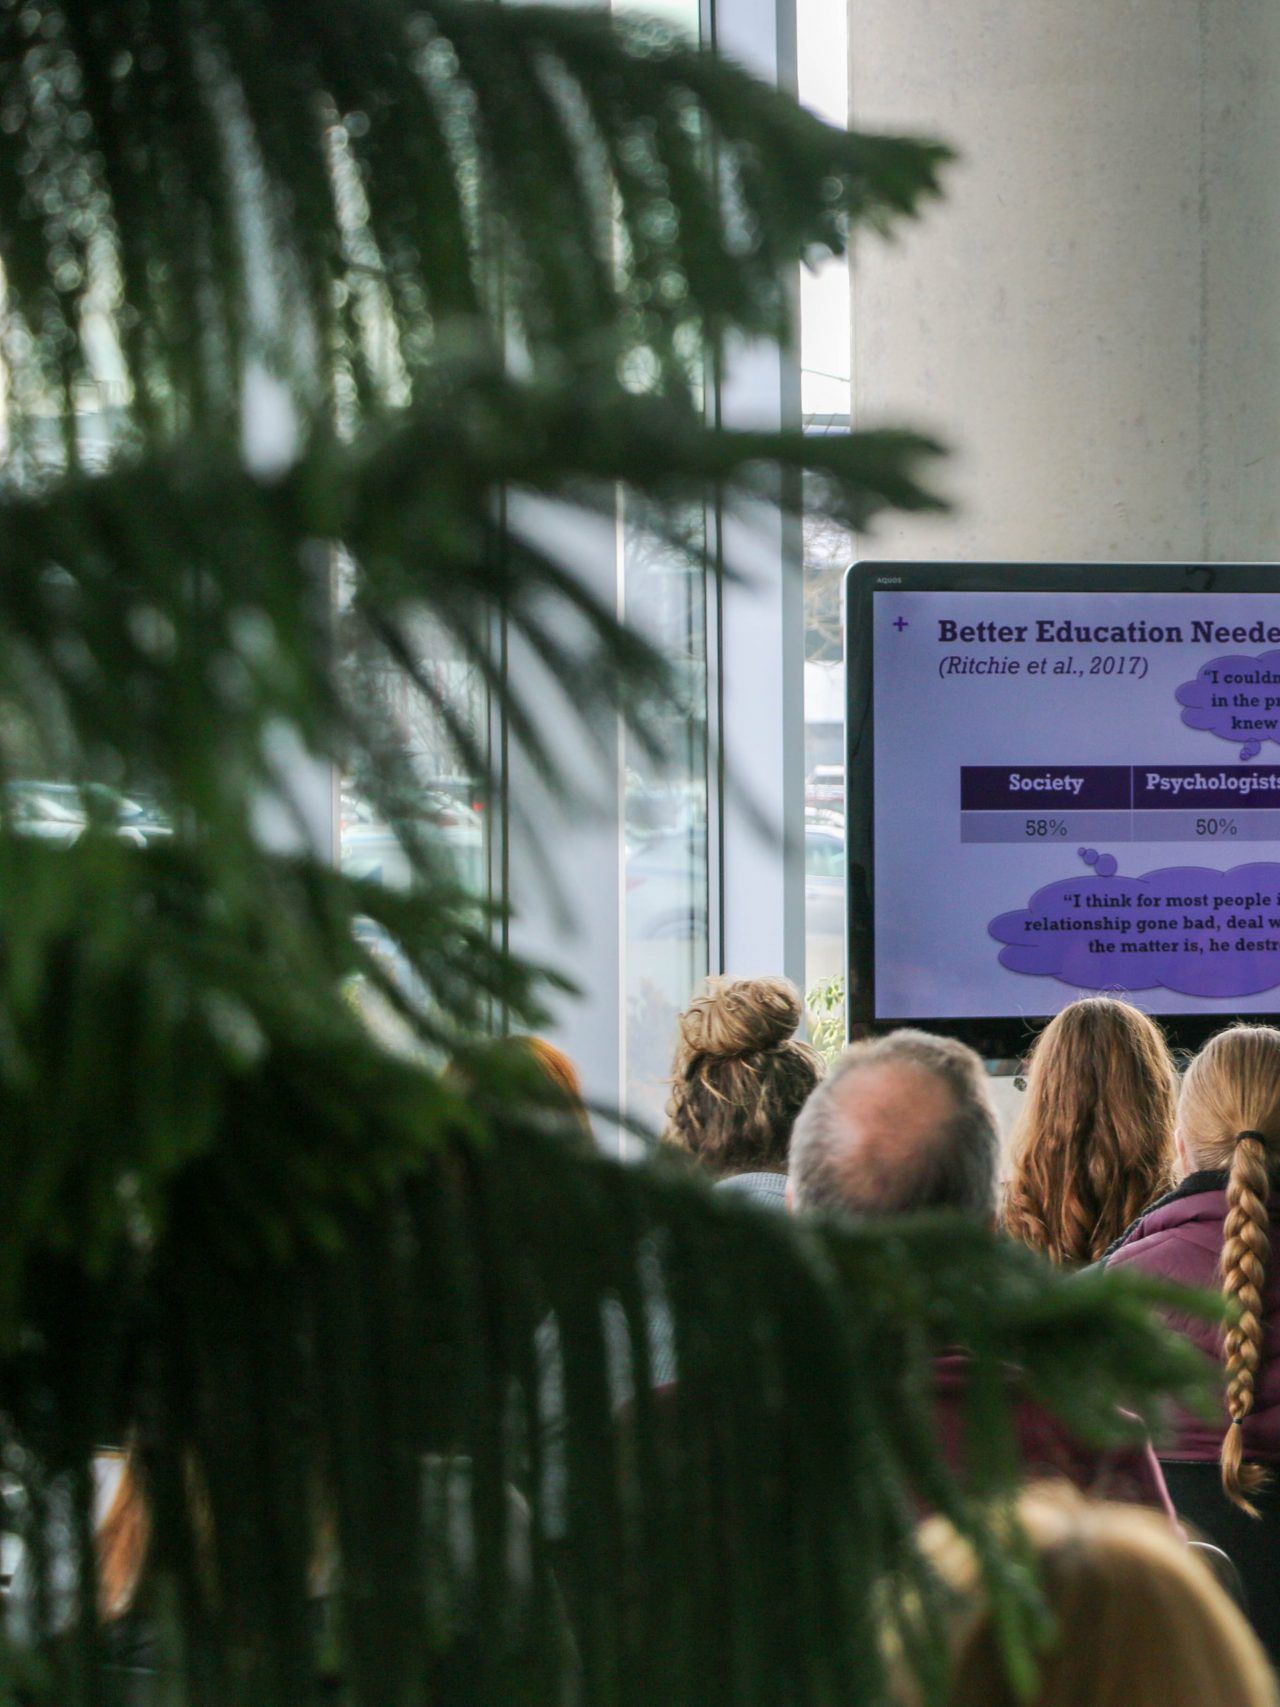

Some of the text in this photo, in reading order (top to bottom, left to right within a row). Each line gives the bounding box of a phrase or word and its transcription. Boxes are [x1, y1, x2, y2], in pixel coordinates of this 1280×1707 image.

[938, 620, 1028, 643] Better
[1035, 620, 1183, 643] Education
[938, 655, 1149, 678] (Ritchie et al., 2017)
[1211, 694, 1228, 707] in
[1233, 694, 1260, 707] the
[1231, 716, 1278, 729] knew
[1008, 773, 1085, 795] Society
[1025, 819, 1068, 837] 58%
[1195, 818, 1238, 835] 50%
[1086, 893, 1133, 907] think
[1137, 893, 1161, 907] for
[1166, 893, 1209, 907] most
[1213, 892, 1271, 910] people
[1024, 917, 1132, 934] relationship
[1136, 919, 1178, 933] gone
[1183, 916, 1222, 932] bad,
[1226, 915, 1264, 929] deal
[1088, 939, 1115, 953] the
[1119, 940, 1179, 953] matter
[1183, 939, 1204, 956] is,
[1209, 938, 1230, 952] he
